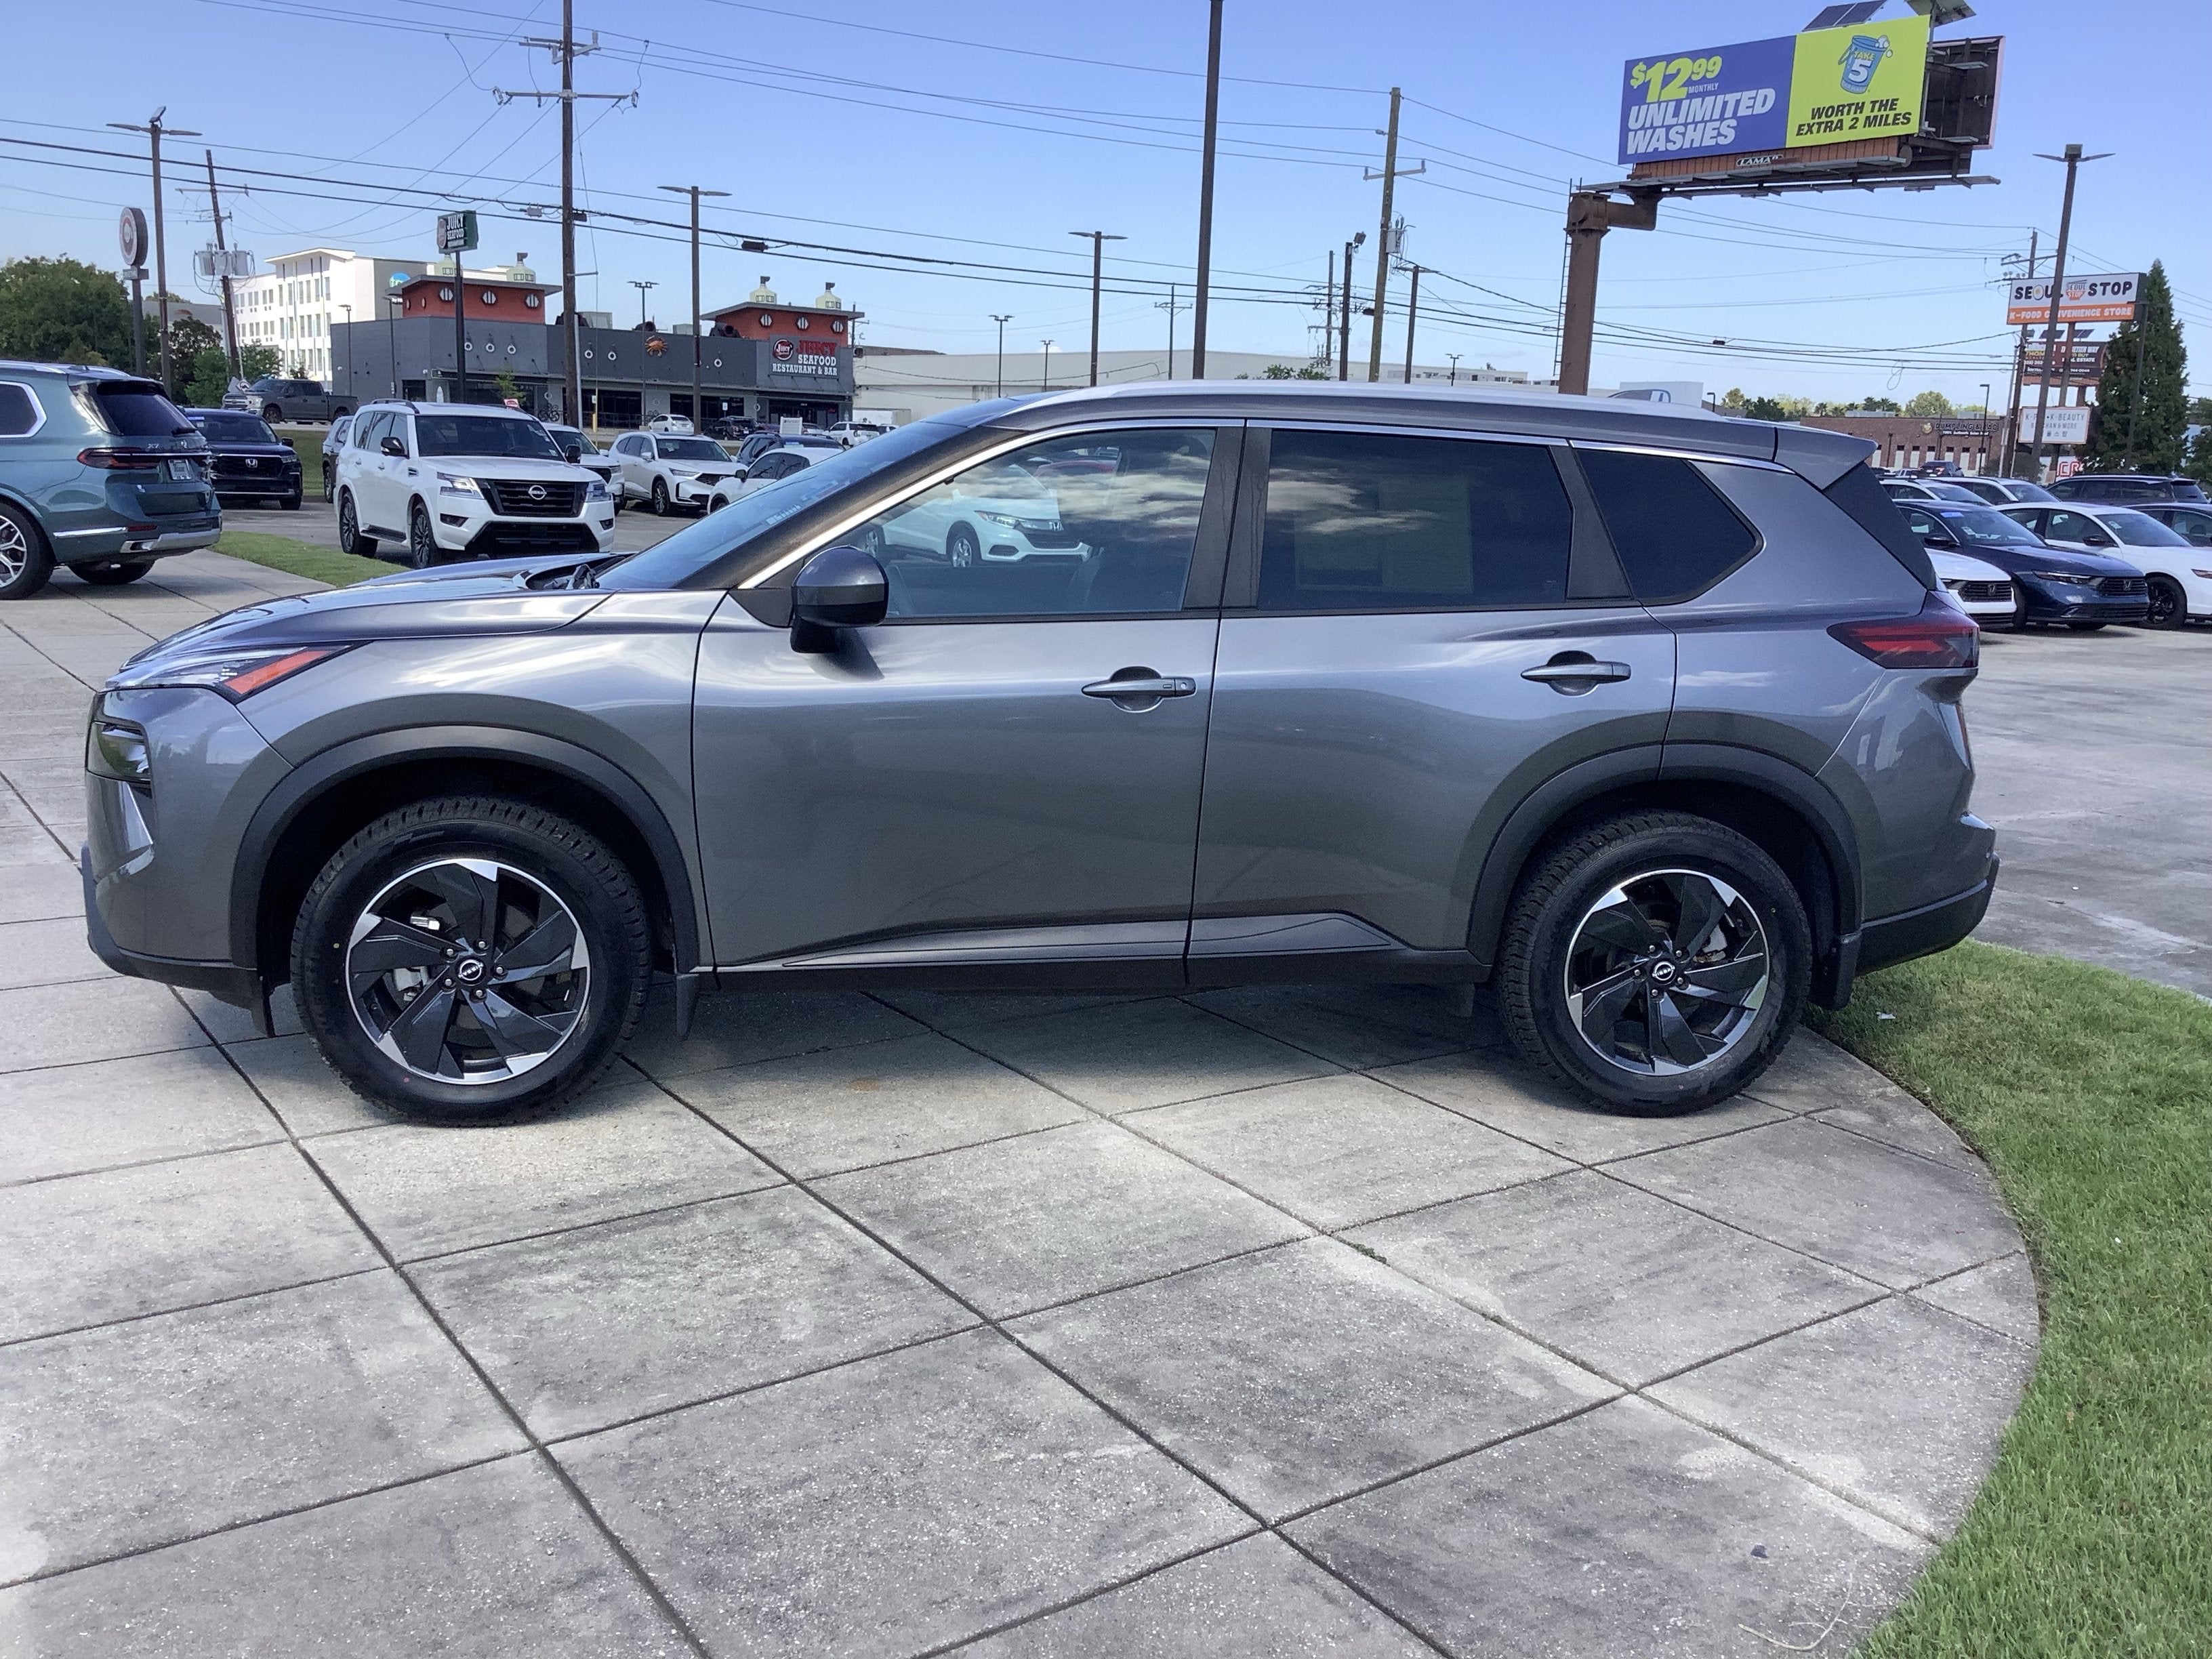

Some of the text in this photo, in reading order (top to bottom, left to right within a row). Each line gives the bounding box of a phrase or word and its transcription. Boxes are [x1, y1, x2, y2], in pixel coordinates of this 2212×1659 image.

[1854, 52, 1875, 61] TAKE
[1848, 58, 1872, 82] 5
[1688, 83, 1719, 94] MONTHLY
[1628, 88, 1776, 129] UNLIMITED
[1811, 98, 1899, 120] WORTH THE
[1796, 112, 1912, 136] EXTRA 2 MILES
[1626, 119, 1737, 155] WASHES
[447, 213, 464, 230] JUICY
[447, 228, 464, 240] SEAFOOD
[2014, 281, 2133, 300] SEOU STOP
[2009, 307, 2132, 319] K-FOOD CVENIENCE STORE
[798, 354, 836, 366] SEAFOOD
[773, 363, 837, 375] RESTAURANT & BAR
[1935, 422, 1973, 430] DUMPLING
[1652, 966, 1675, 977] NISSAN
